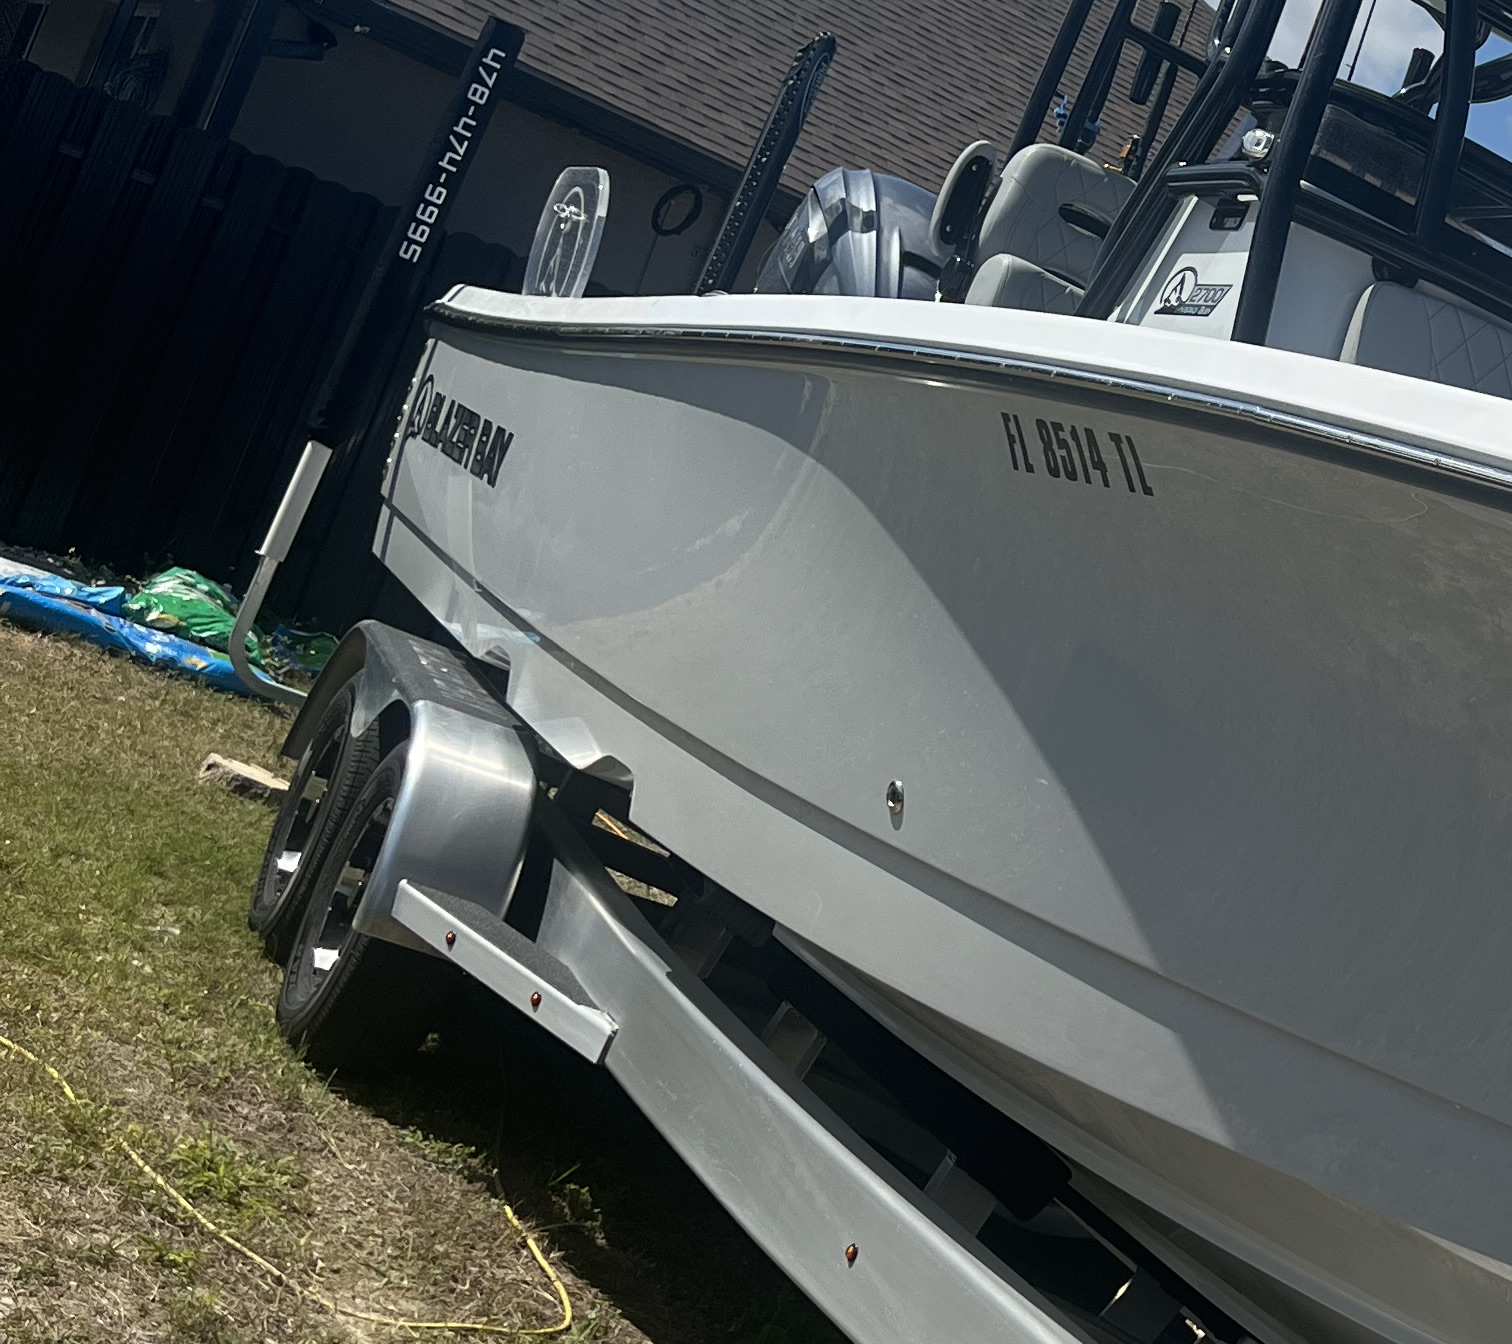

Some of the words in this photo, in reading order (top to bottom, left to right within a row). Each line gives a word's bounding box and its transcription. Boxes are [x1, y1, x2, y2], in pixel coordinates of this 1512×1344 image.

[399, 47, 506, 263] 478-474-9995
[1189, 287, 1225, 303] 2700
[421, 391, 482, 470] BLAZER
[1000, 411, 1035, 474] FL
[1035, 418, 1111, 488] 8514
[1107, 431, 1154, 497] TL
